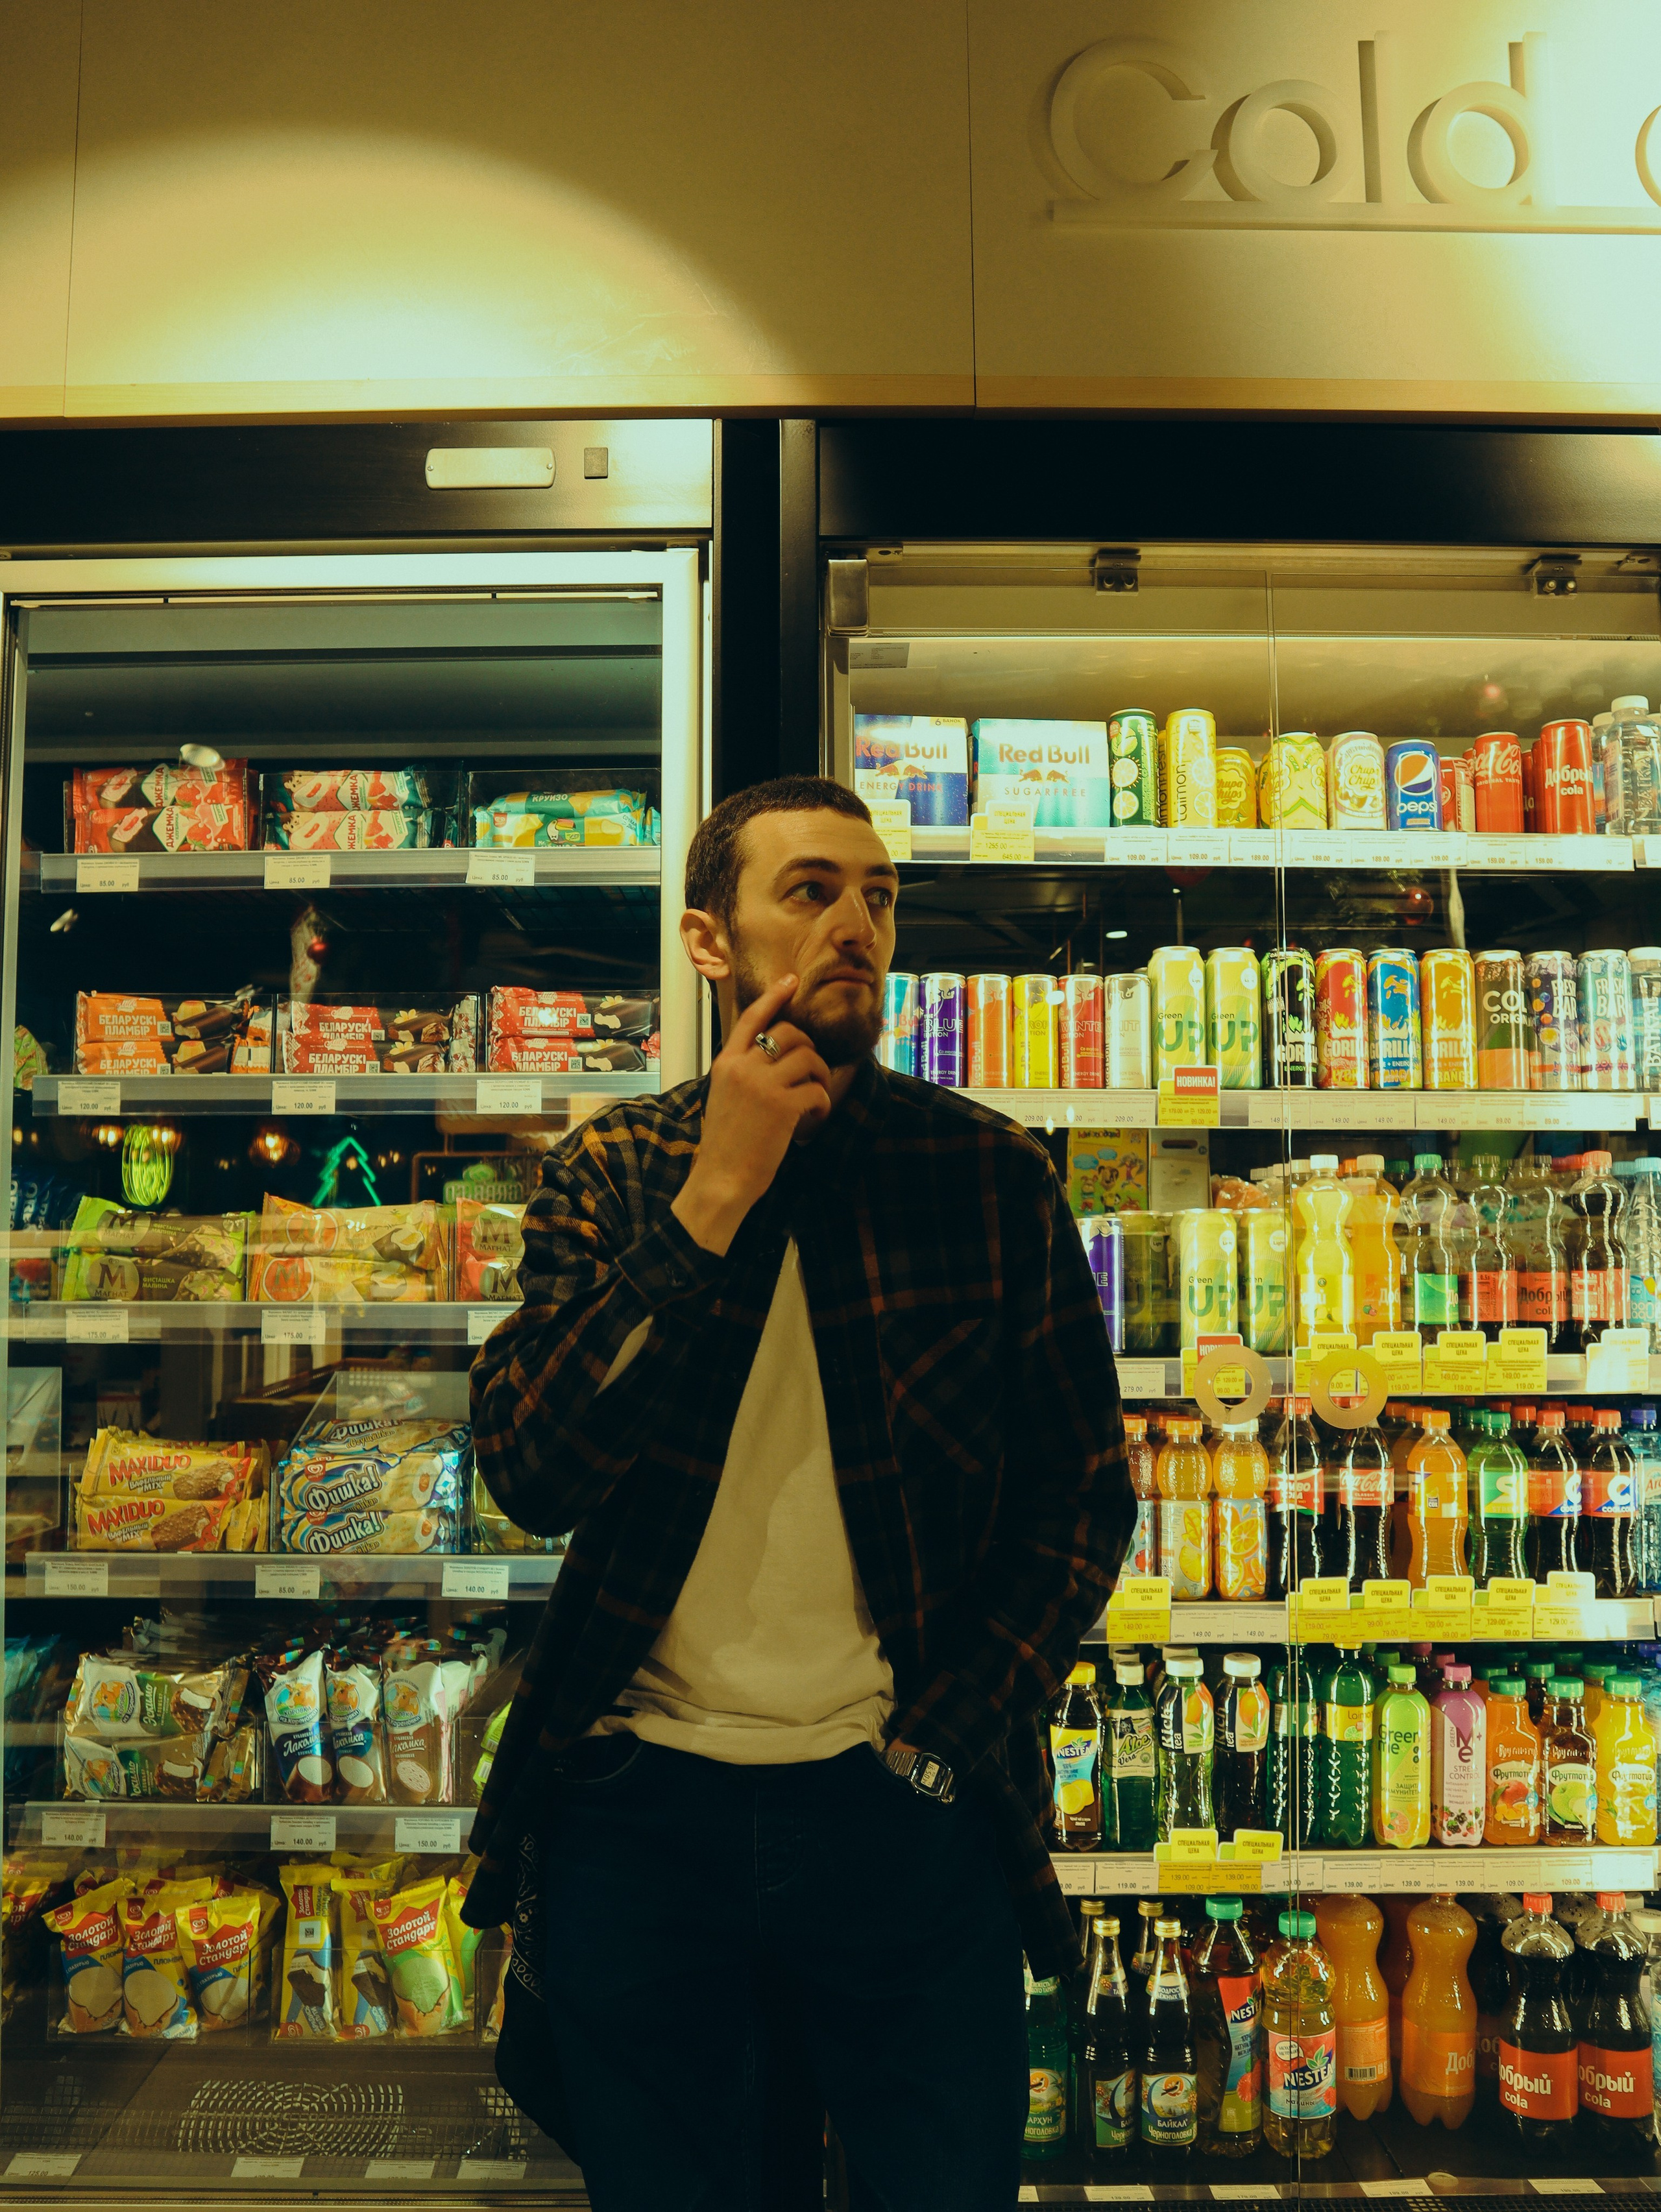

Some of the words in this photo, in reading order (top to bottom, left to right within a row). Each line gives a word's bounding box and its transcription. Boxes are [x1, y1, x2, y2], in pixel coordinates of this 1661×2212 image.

[1050, 30, 1548, 205] Cold
[855, 736, 901, 759] Red
[904, 743, 948, 760] Bull
[999, 744, 1043, 764] Red
[1048, 745, 1090, 765] Bull
[1545, 764, 1594, 788] Добрый
[155, 767, 164, 807] ДЖЕМКА
[860, 782, 904, 790] ENERGY
[909, 782, 943, 793] DRINK
[1004, 787, 1086, 797] SUGARFREE
[1174, 763, 1187, 822] Laimon
[1560, 784, 1584, 796] cola
[532, 793, 568, 802] КРУИЗО
[1396, 800, 1438, 816] pepsi
[99, 1015, 157, 1025] БЕЛАРУСКІ
[1158, 1012, 1183, 1020] Green
[1211, 1012, 1235, 1020] Green
[104, 1026, 151, 1036] ПЛАМБІР
[319, 1022, 371, 1033] БЕЛАРУСКІ
[1158, 1020, 1204, 1052] UP
[1211, 1020, 1258, 1052] UP
[100, 1058, 157, 1070] БЕЛАРУСКІ
[308, 1053, 367, 1064] БЕЛАРУСКІ
[511, 1051, 568, 1061] БЕЛАРУСКІ
[313, 1064, 359, 1074] ПЛАМБІР
[1176, 1076, 1216, 1088] НОВИНКА!
[1189, 1275, 1213, 1284] Green
[94, 1289, 129, 1298] МАГНАТ
[1189, 1285, 1236, 1317] UP
[107, 1454, 192, 1487] MAXIDUO
[129, 1474, 172, 1491] ВАФЕЛЬНЫЙ
[143, 1482, 162, 1492] MIX
[307, 1464, 382, 1511] Фишка!
[87, 1499, 165, 1537] MAXIDUO
[121, 1532, 142, 1543] MIX
[309, 1511, 383, 1553] Фишка!
[143, 1683, 157, 1727] Эскимо
[283, 1705, 311, 1718] КОРОВКА
[1161, 1702, 1174, 1749] Rich
[1378, 1724, 1421, 1744] Green
[283, 1733, 324, 1757] Лакомка
[1057, 1747, 1092, 1758] NESTEA
[1117, 1734, 1152, 1759] Aloe
[1118, 1753, 1137, 1766] Vera
[67, 1914, 114, 1942] Золотой
[133, 1920, 171, 1942] Золотой
[387, 1910, 431, 1939] Золотой
[130, 1932, 175, 1952] Стандарт
[201, 1929, 249, 1955] Золотой
[386, 1919, 437, 1951] Стандарт
[199, 1941, 249, 1967] Стандарт
[1283, 2063, 1333, 2087] NESTEA
[1505, 2091, 1528, 2110] cola
[1584, 2091, 1611, 2108] cola
[1148, 2125, 1193, 2139] Черноголовка
[1157, 2119, 1187, 2128] БАЙКАЛ
